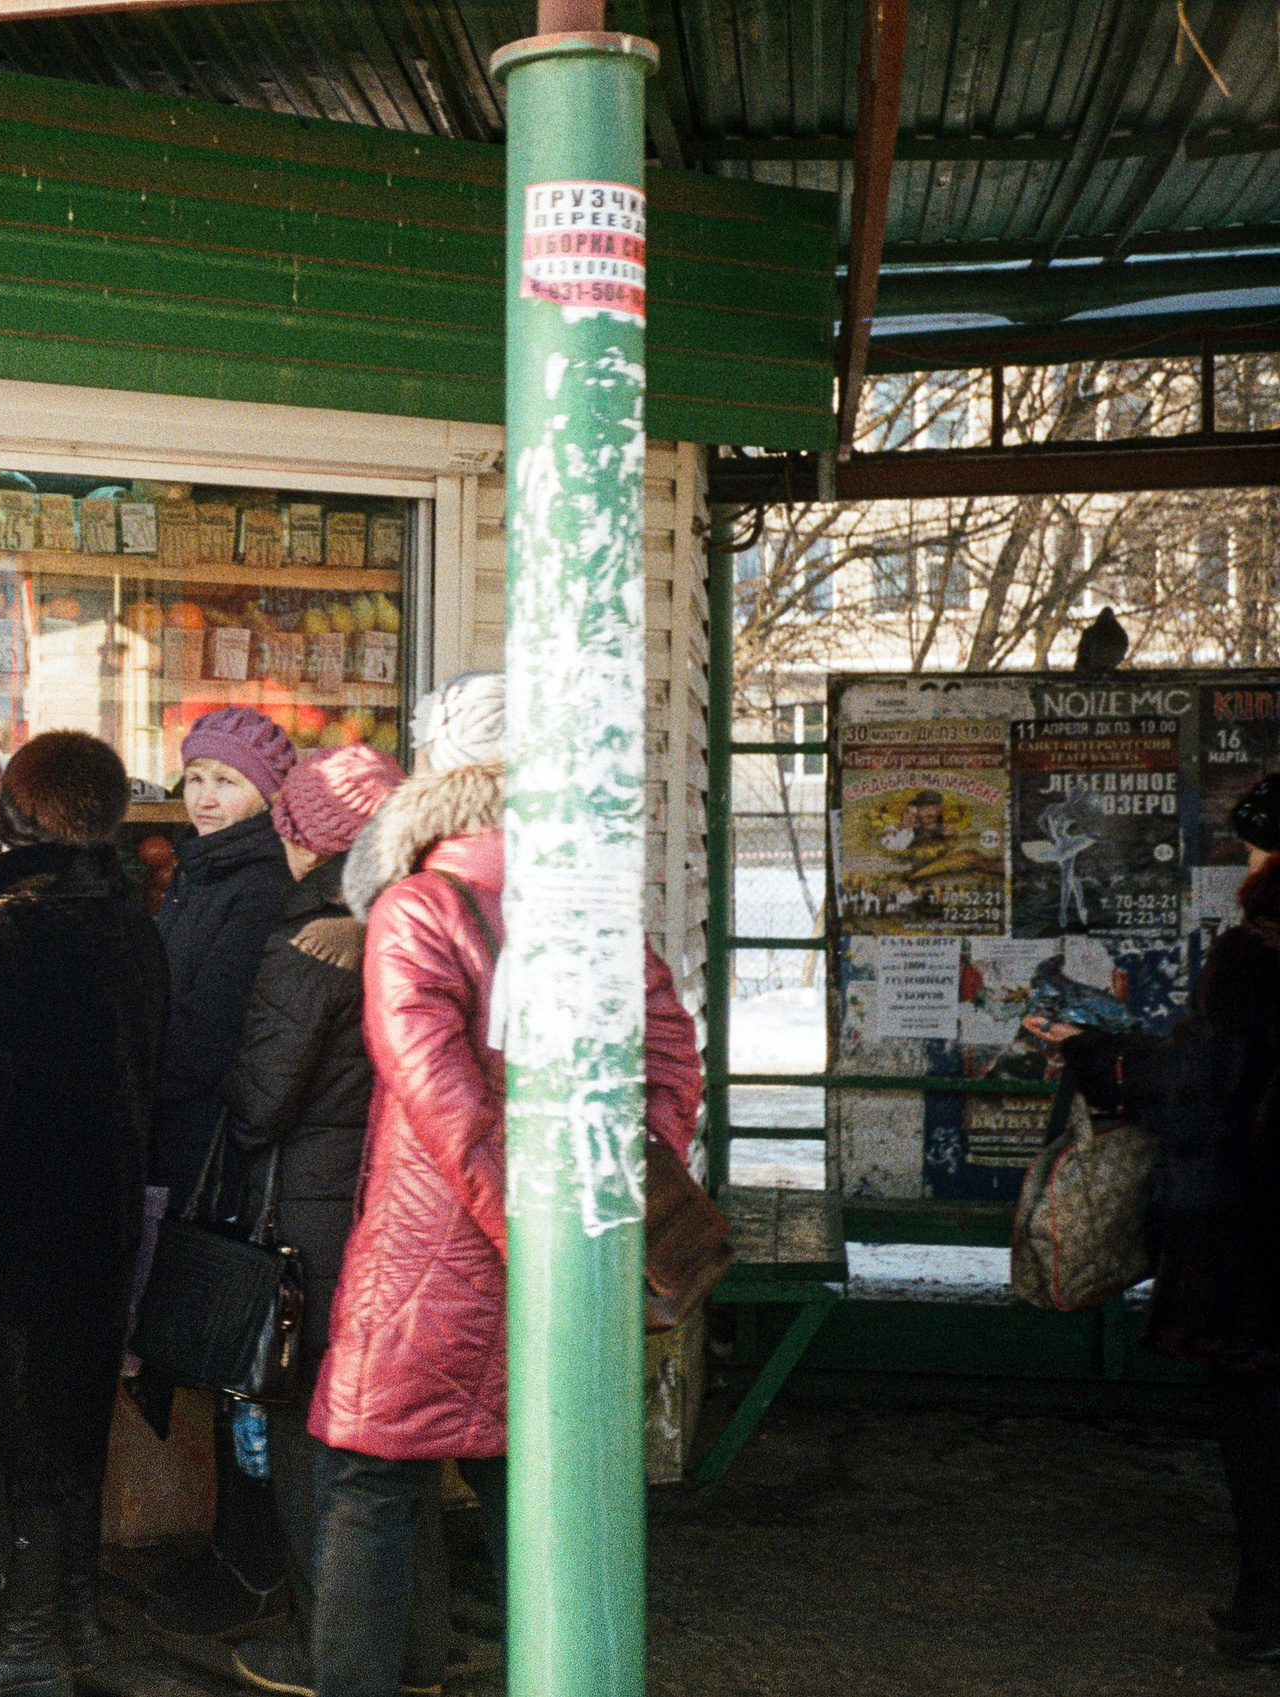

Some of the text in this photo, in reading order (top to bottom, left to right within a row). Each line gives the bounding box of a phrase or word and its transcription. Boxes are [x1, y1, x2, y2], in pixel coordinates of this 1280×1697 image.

[533, 188, 644, 215] ГРУЗЧИ
[534, 260, 643, 281] РАЗНОРАБО
[1043, 689, 1192, 717] NOIZE MC
[846, 726, 867, 742] 30
[871, 729, 910, 743] марта
[917, 726, 935, 741] ДК
[1017, 723, 1035, 739] 11
[1041, 722, 1089, 736] АПРЕЛЯ
[1094, 723, 1111, 737] ДК
[1140, 720, 1177, 733] 19.00
[1217, 729, 1241, 750] 16
[1208, 751, 1249, 763] МАРТА
[908, 771, 917, 787] В
[1040, 773, 1177, 794] ЛЕБЕДИНОЕ
[1101, 795, 1177, 816] ОЗЕРО
[1116, 895, 1177, 910] 70-52-21
[943, 907, 1000, 922] 72-23-19
[1117, 911, 1177, 926] 72-23-19
